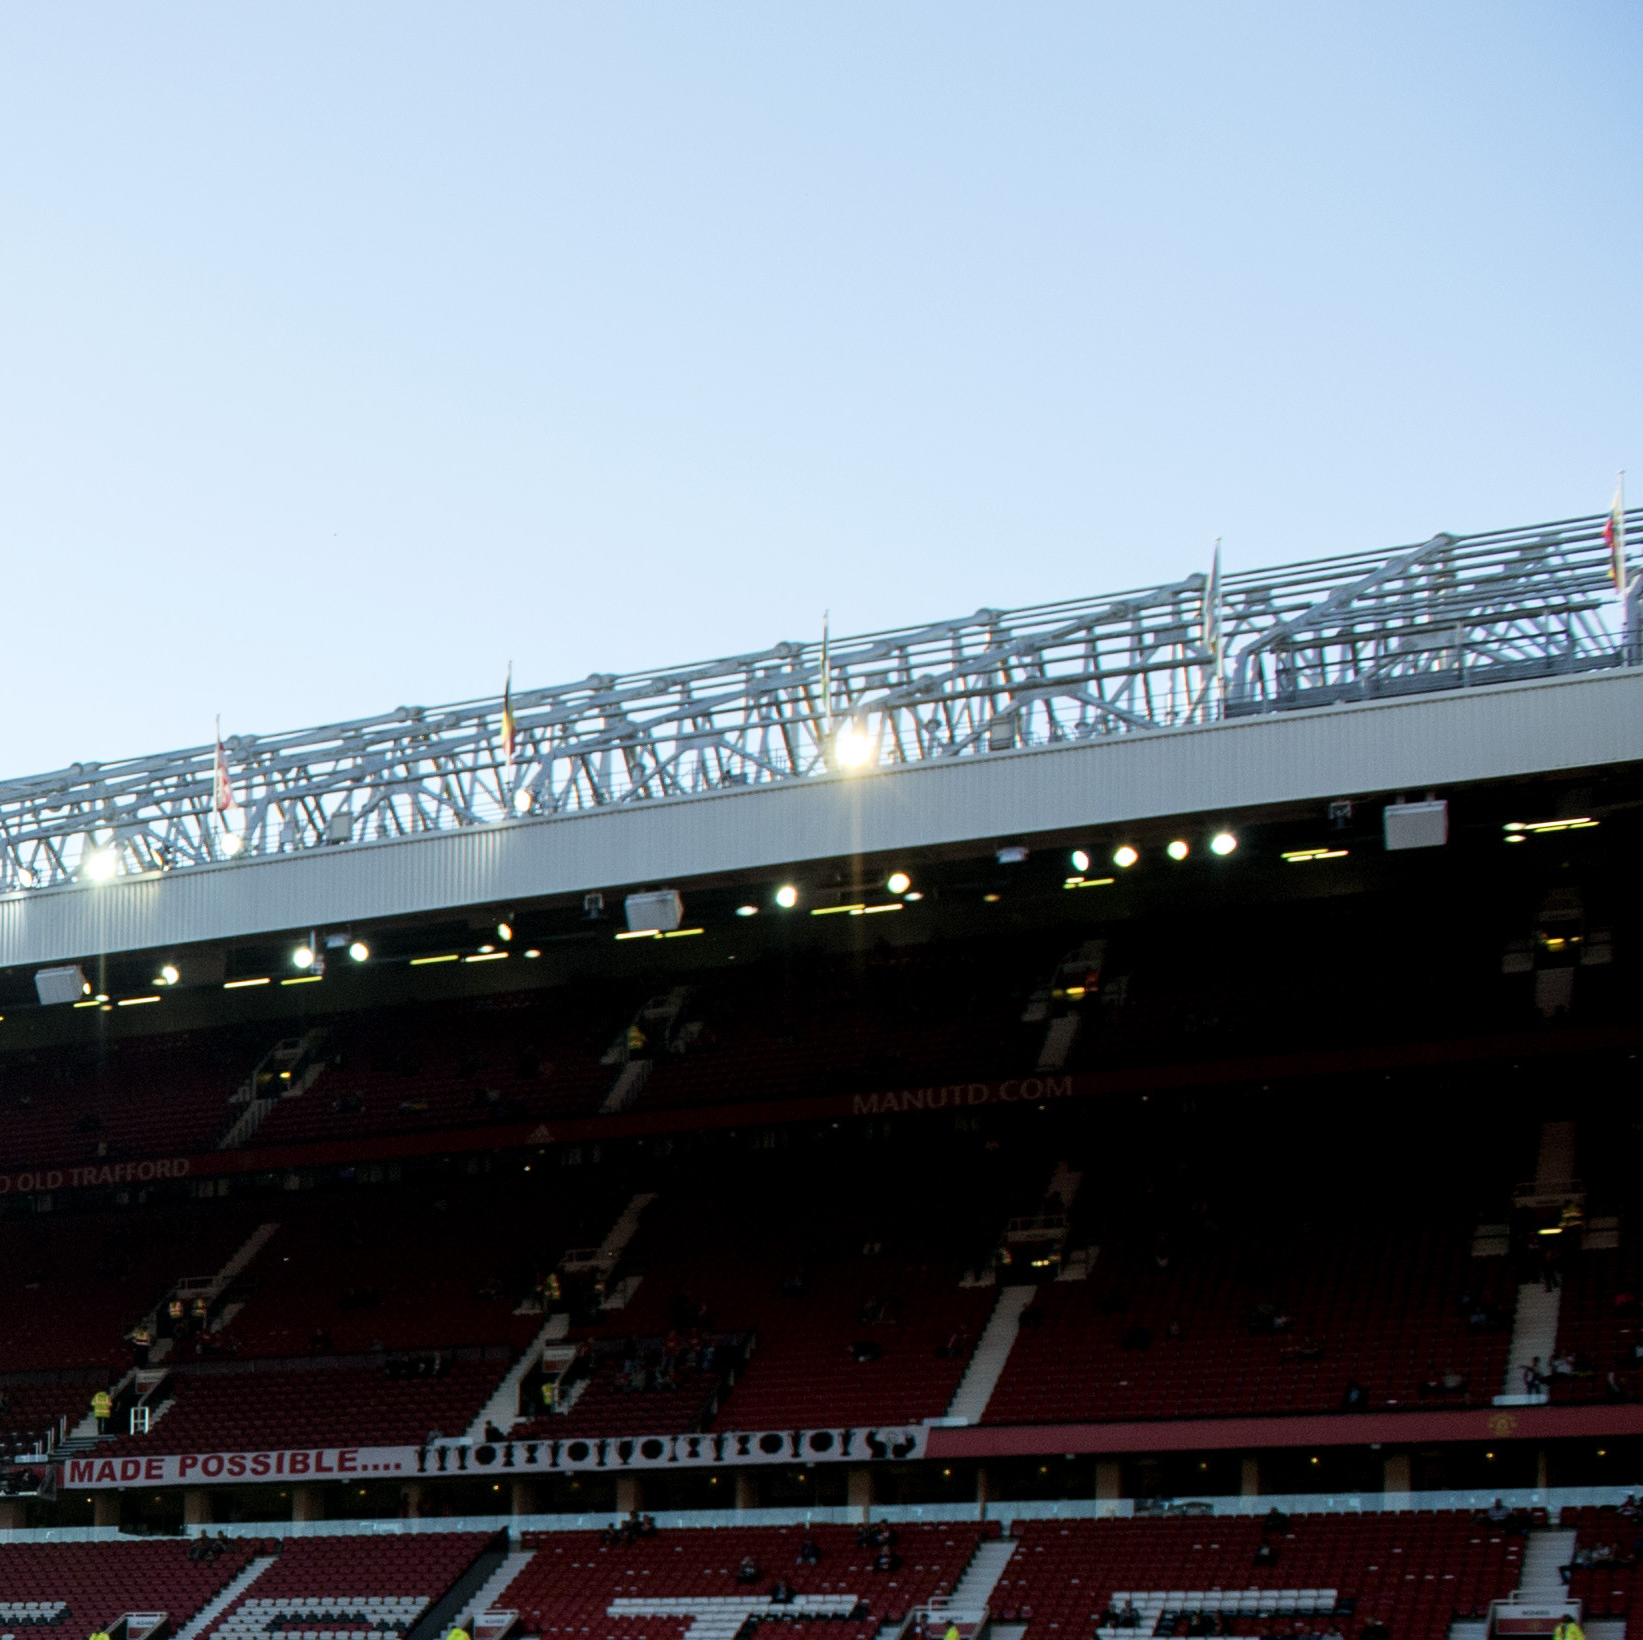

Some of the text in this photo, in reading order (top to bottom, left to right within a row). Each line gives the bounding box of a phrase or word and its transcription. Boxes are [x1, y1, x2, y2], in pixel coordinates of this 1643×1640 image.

[853, 1076, 1072, 1115] MANUTD.COM
[17, 1169, 64, 1191] OLD
[69, 1157, 191, 1188] TRAFFORD
[68, 1458, 165, 1483] MADE
